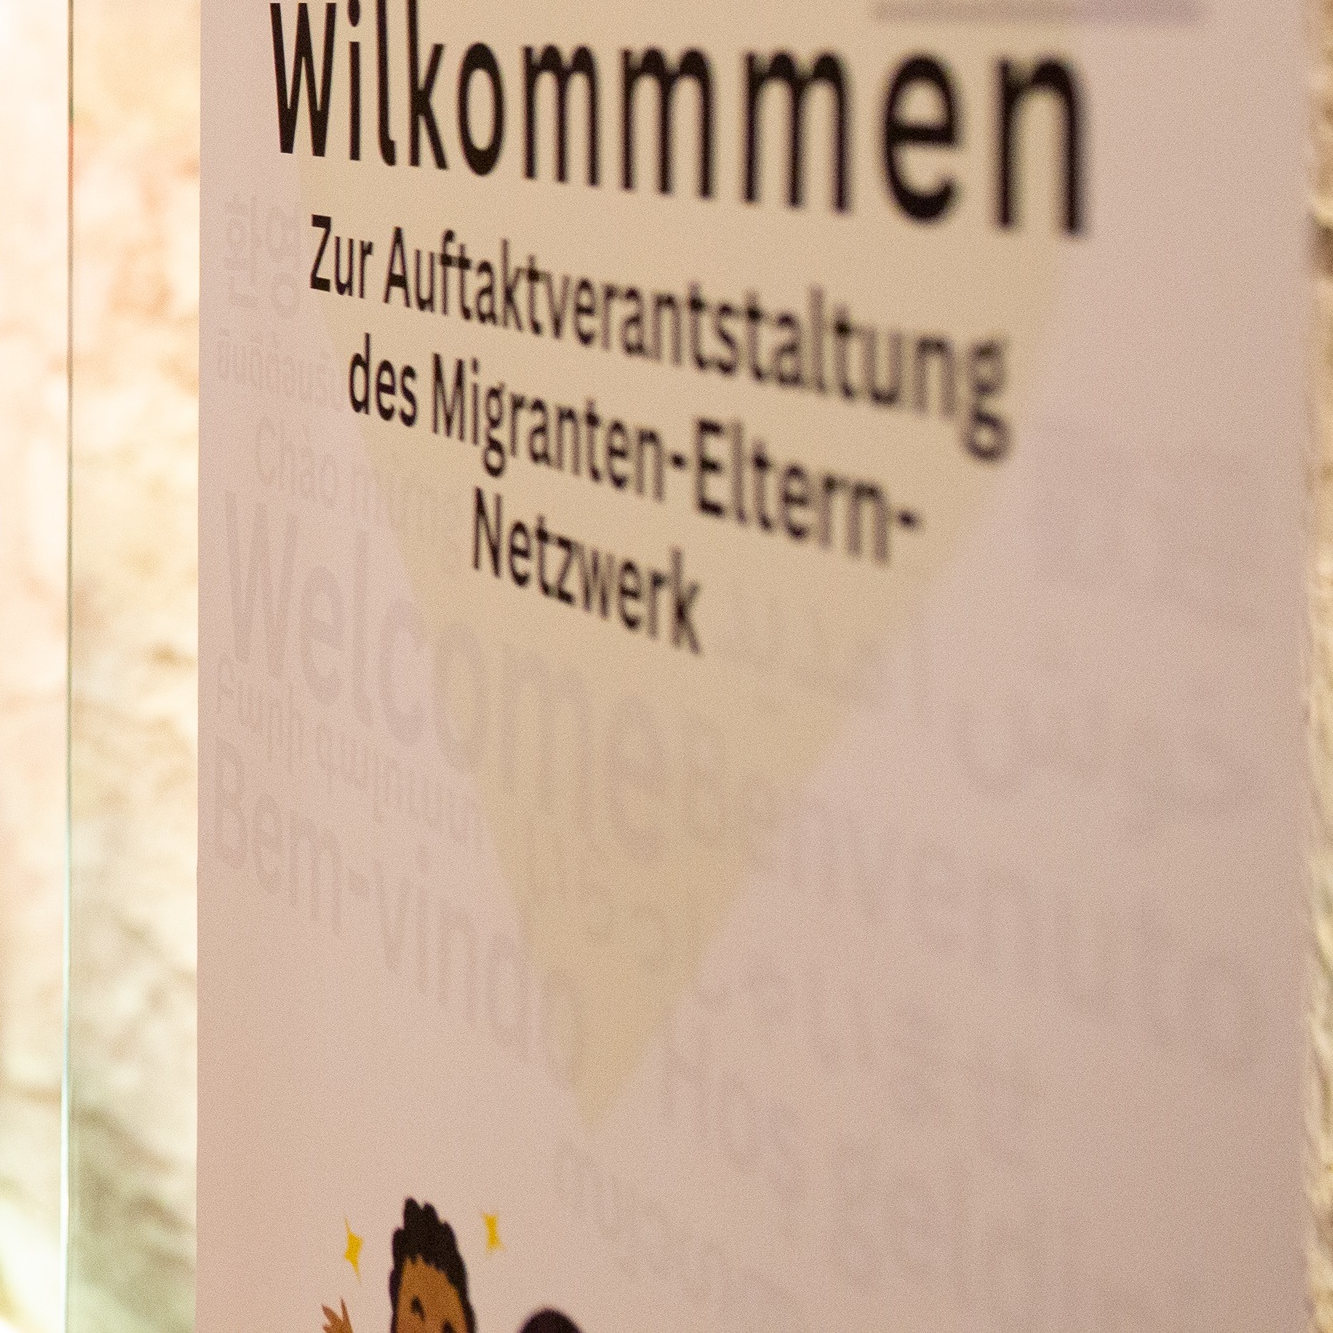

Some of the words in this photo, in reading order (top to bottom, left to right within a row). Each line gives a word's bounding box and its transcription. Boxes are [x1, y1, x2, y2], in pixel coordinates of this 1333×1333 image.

[310, 213, 375, 300] Zur
[383, 226, 1009, 463] Auftaktverantstaltung
[348, 332, 419, 428] des
[432, 353, 921, 556] Migranten-Eltern-
[226, 492, 667, 867] Welcome
[473, 487, 701, 652] Netzwerk
[215, 738, 587, 1091] Bem-vindo
[683, 704, 1266, 1080] Benvenuto
